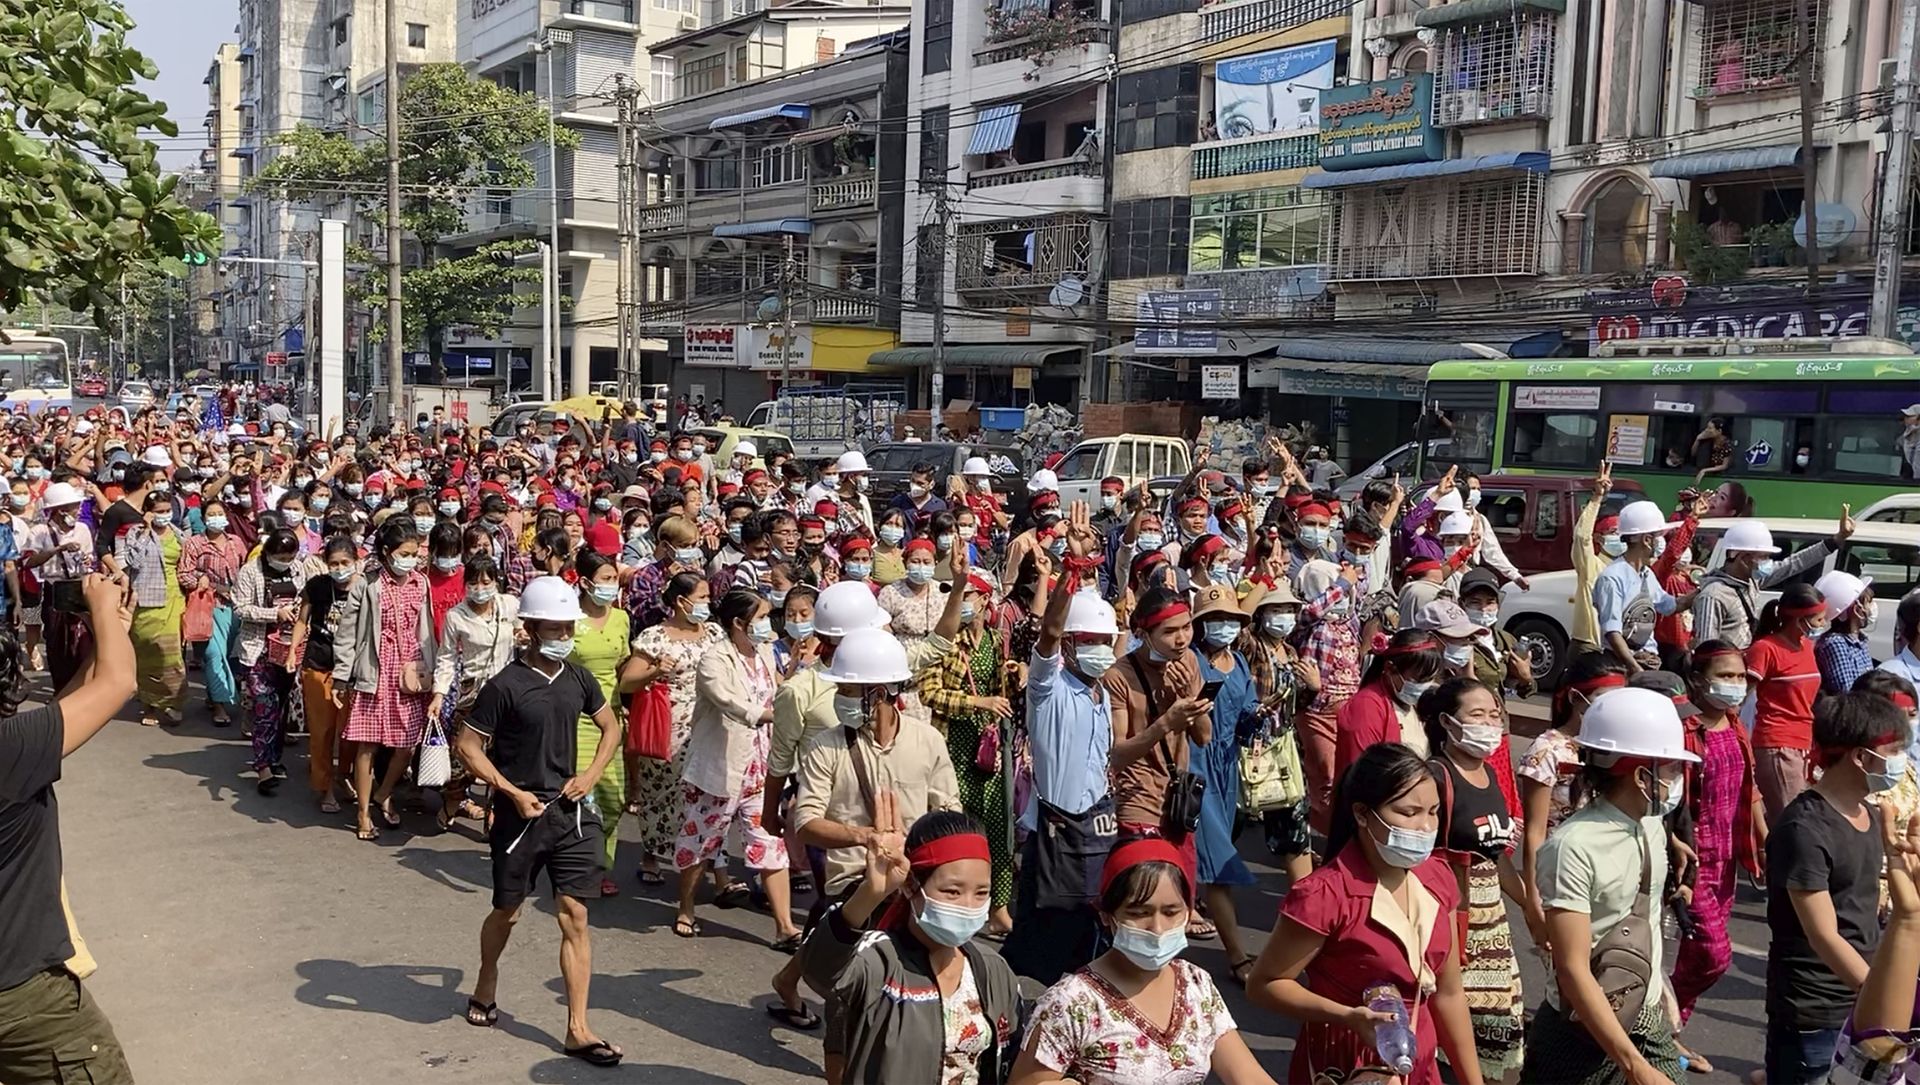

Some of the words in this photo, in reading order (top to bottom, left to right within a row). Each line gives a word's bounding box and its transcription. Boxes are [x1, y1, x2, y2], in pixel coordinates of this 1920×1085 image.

[1373, 136, 1404, 152] EMPLOYMENT
[1404, 134, 1423, 148] AGENCY
[758, 351, 782, 359] Beauty
[1473, 814, 1519, 841] FILA
